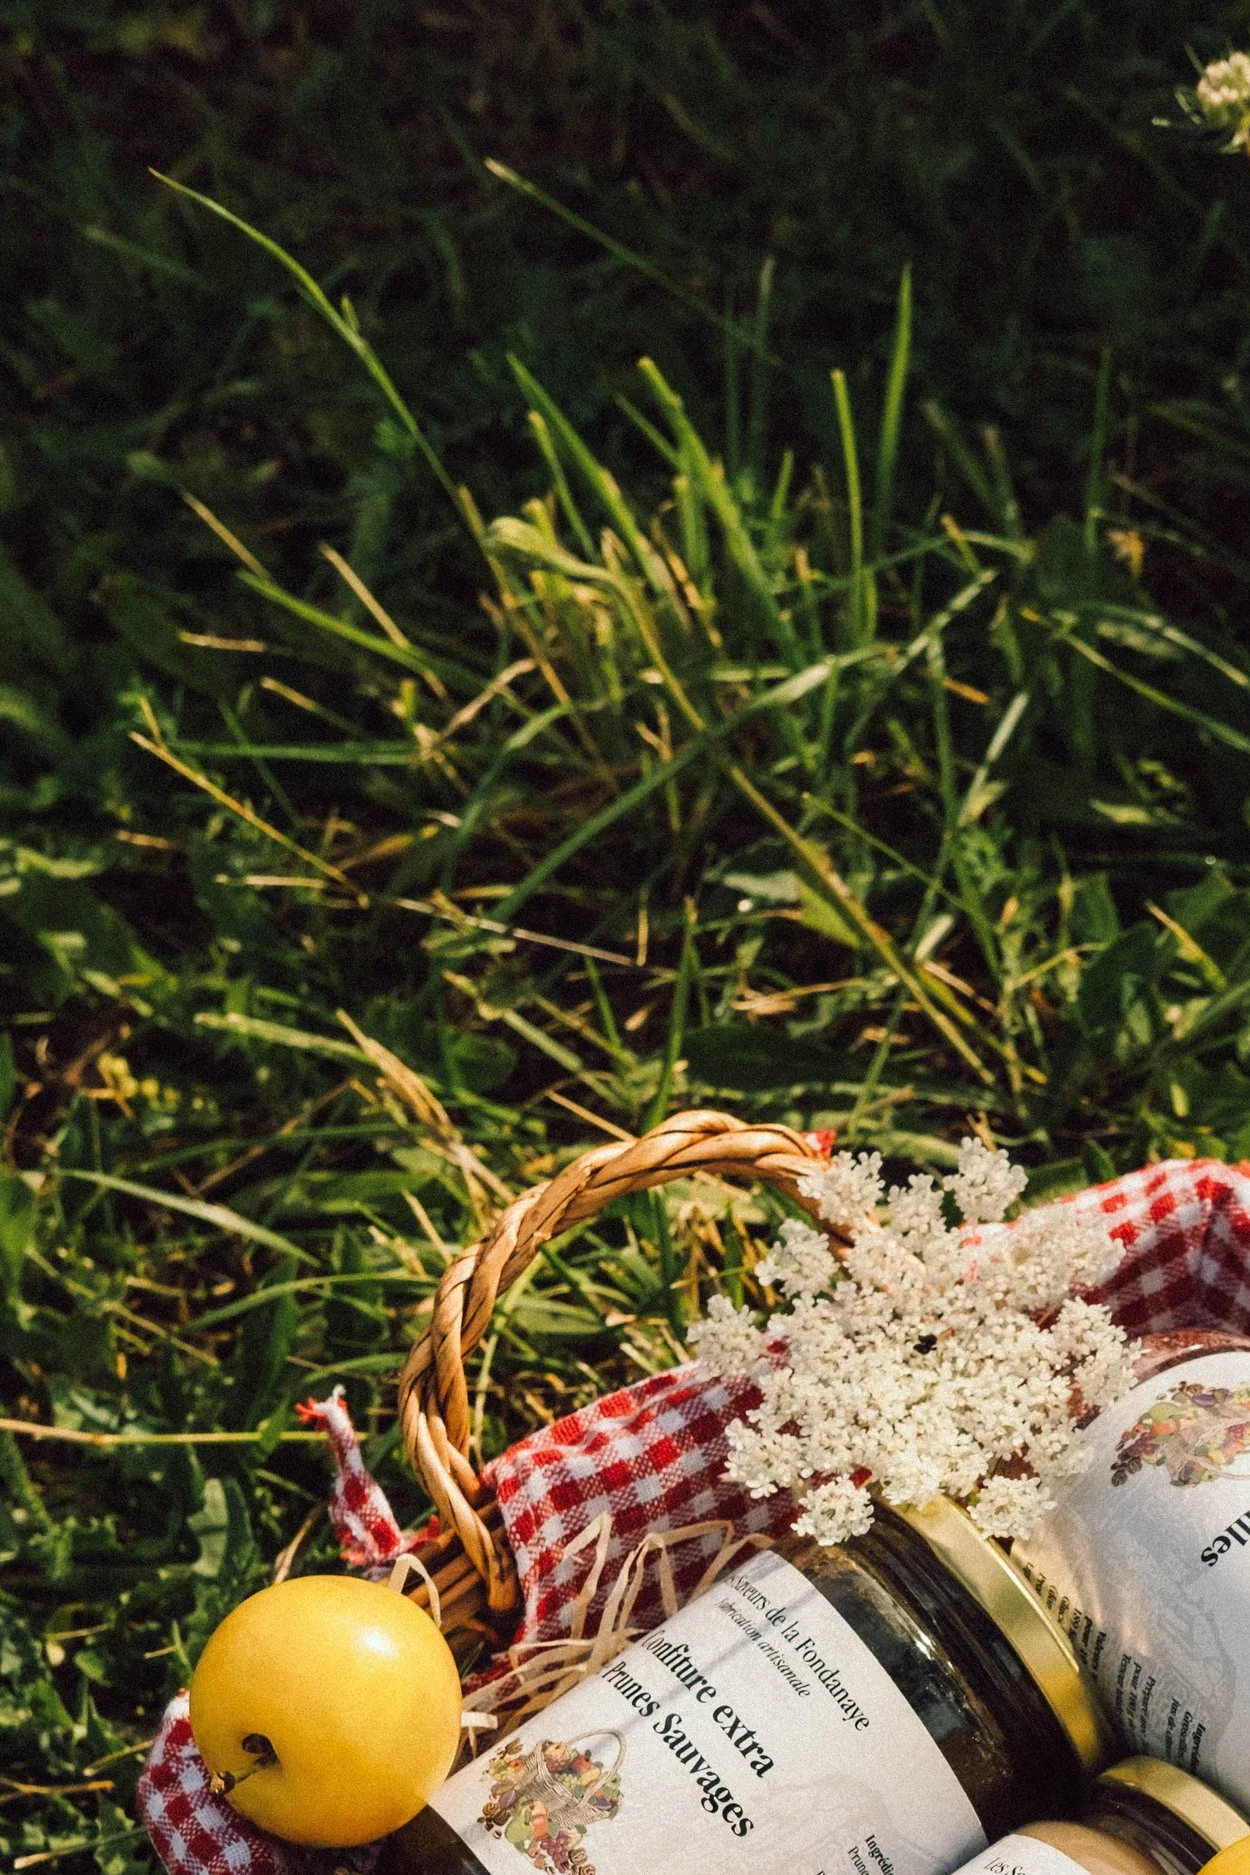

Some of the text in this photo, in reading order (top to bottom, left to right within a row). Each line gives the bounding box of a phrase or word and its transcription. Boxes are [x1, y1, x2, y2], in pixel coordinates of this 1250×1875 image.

[641, 1629, 775, 1778] Confiture extra
[757, 1640, 811, 1697] artisanale
[765, 1607, 787, 1627] de
[781, 1621, 801, 1643] la
[796, 1637, 870, 1731] Fondanaye
[602, 1661, 754, 1837] Prunes Sauvages
